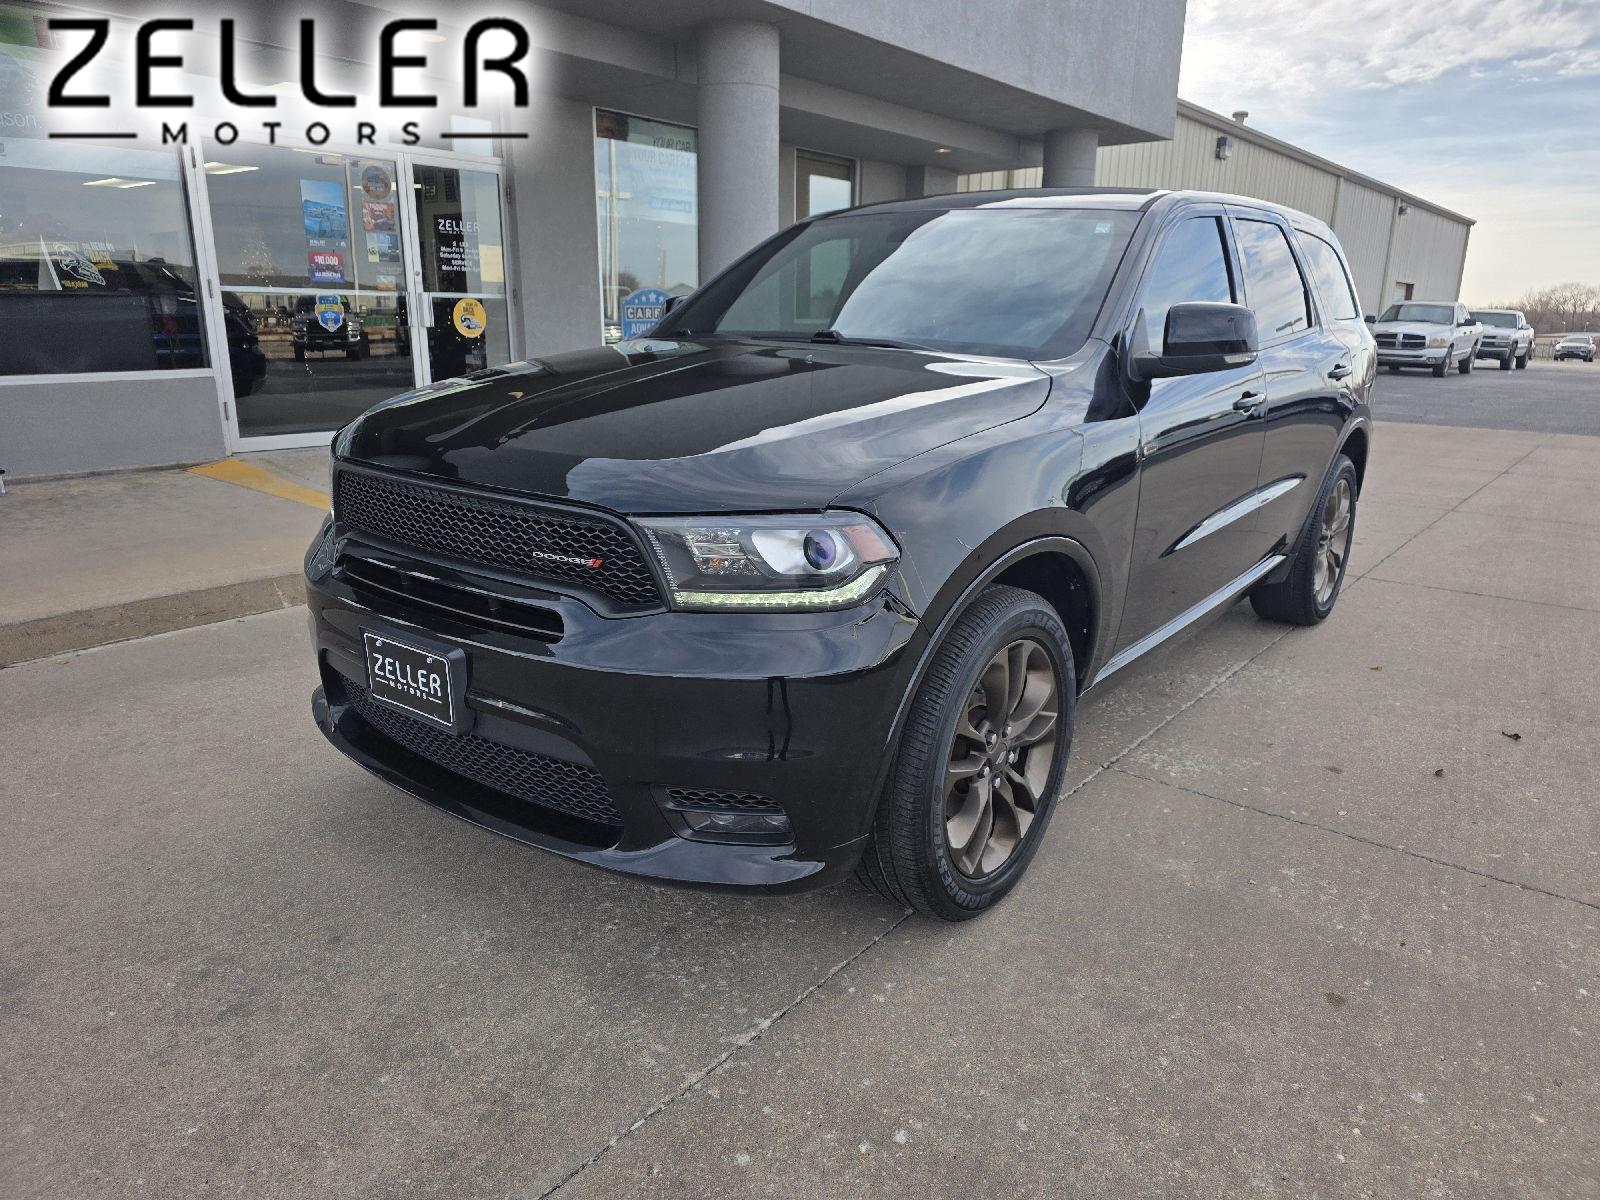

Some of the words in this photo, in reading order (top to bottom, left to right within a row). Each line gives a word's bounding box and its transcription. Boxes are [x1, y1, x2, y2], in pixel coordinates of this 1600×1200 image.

[438, 218, 480, 232] ZELLER
[627, 308, 661, 319] CARF
[631, 322, 654, 334] ADVA
[532, 551, 592, 567] DODGE
[372, 652, 442, 697] ZELLER
[389, 680, 427, 700] MOTORS
